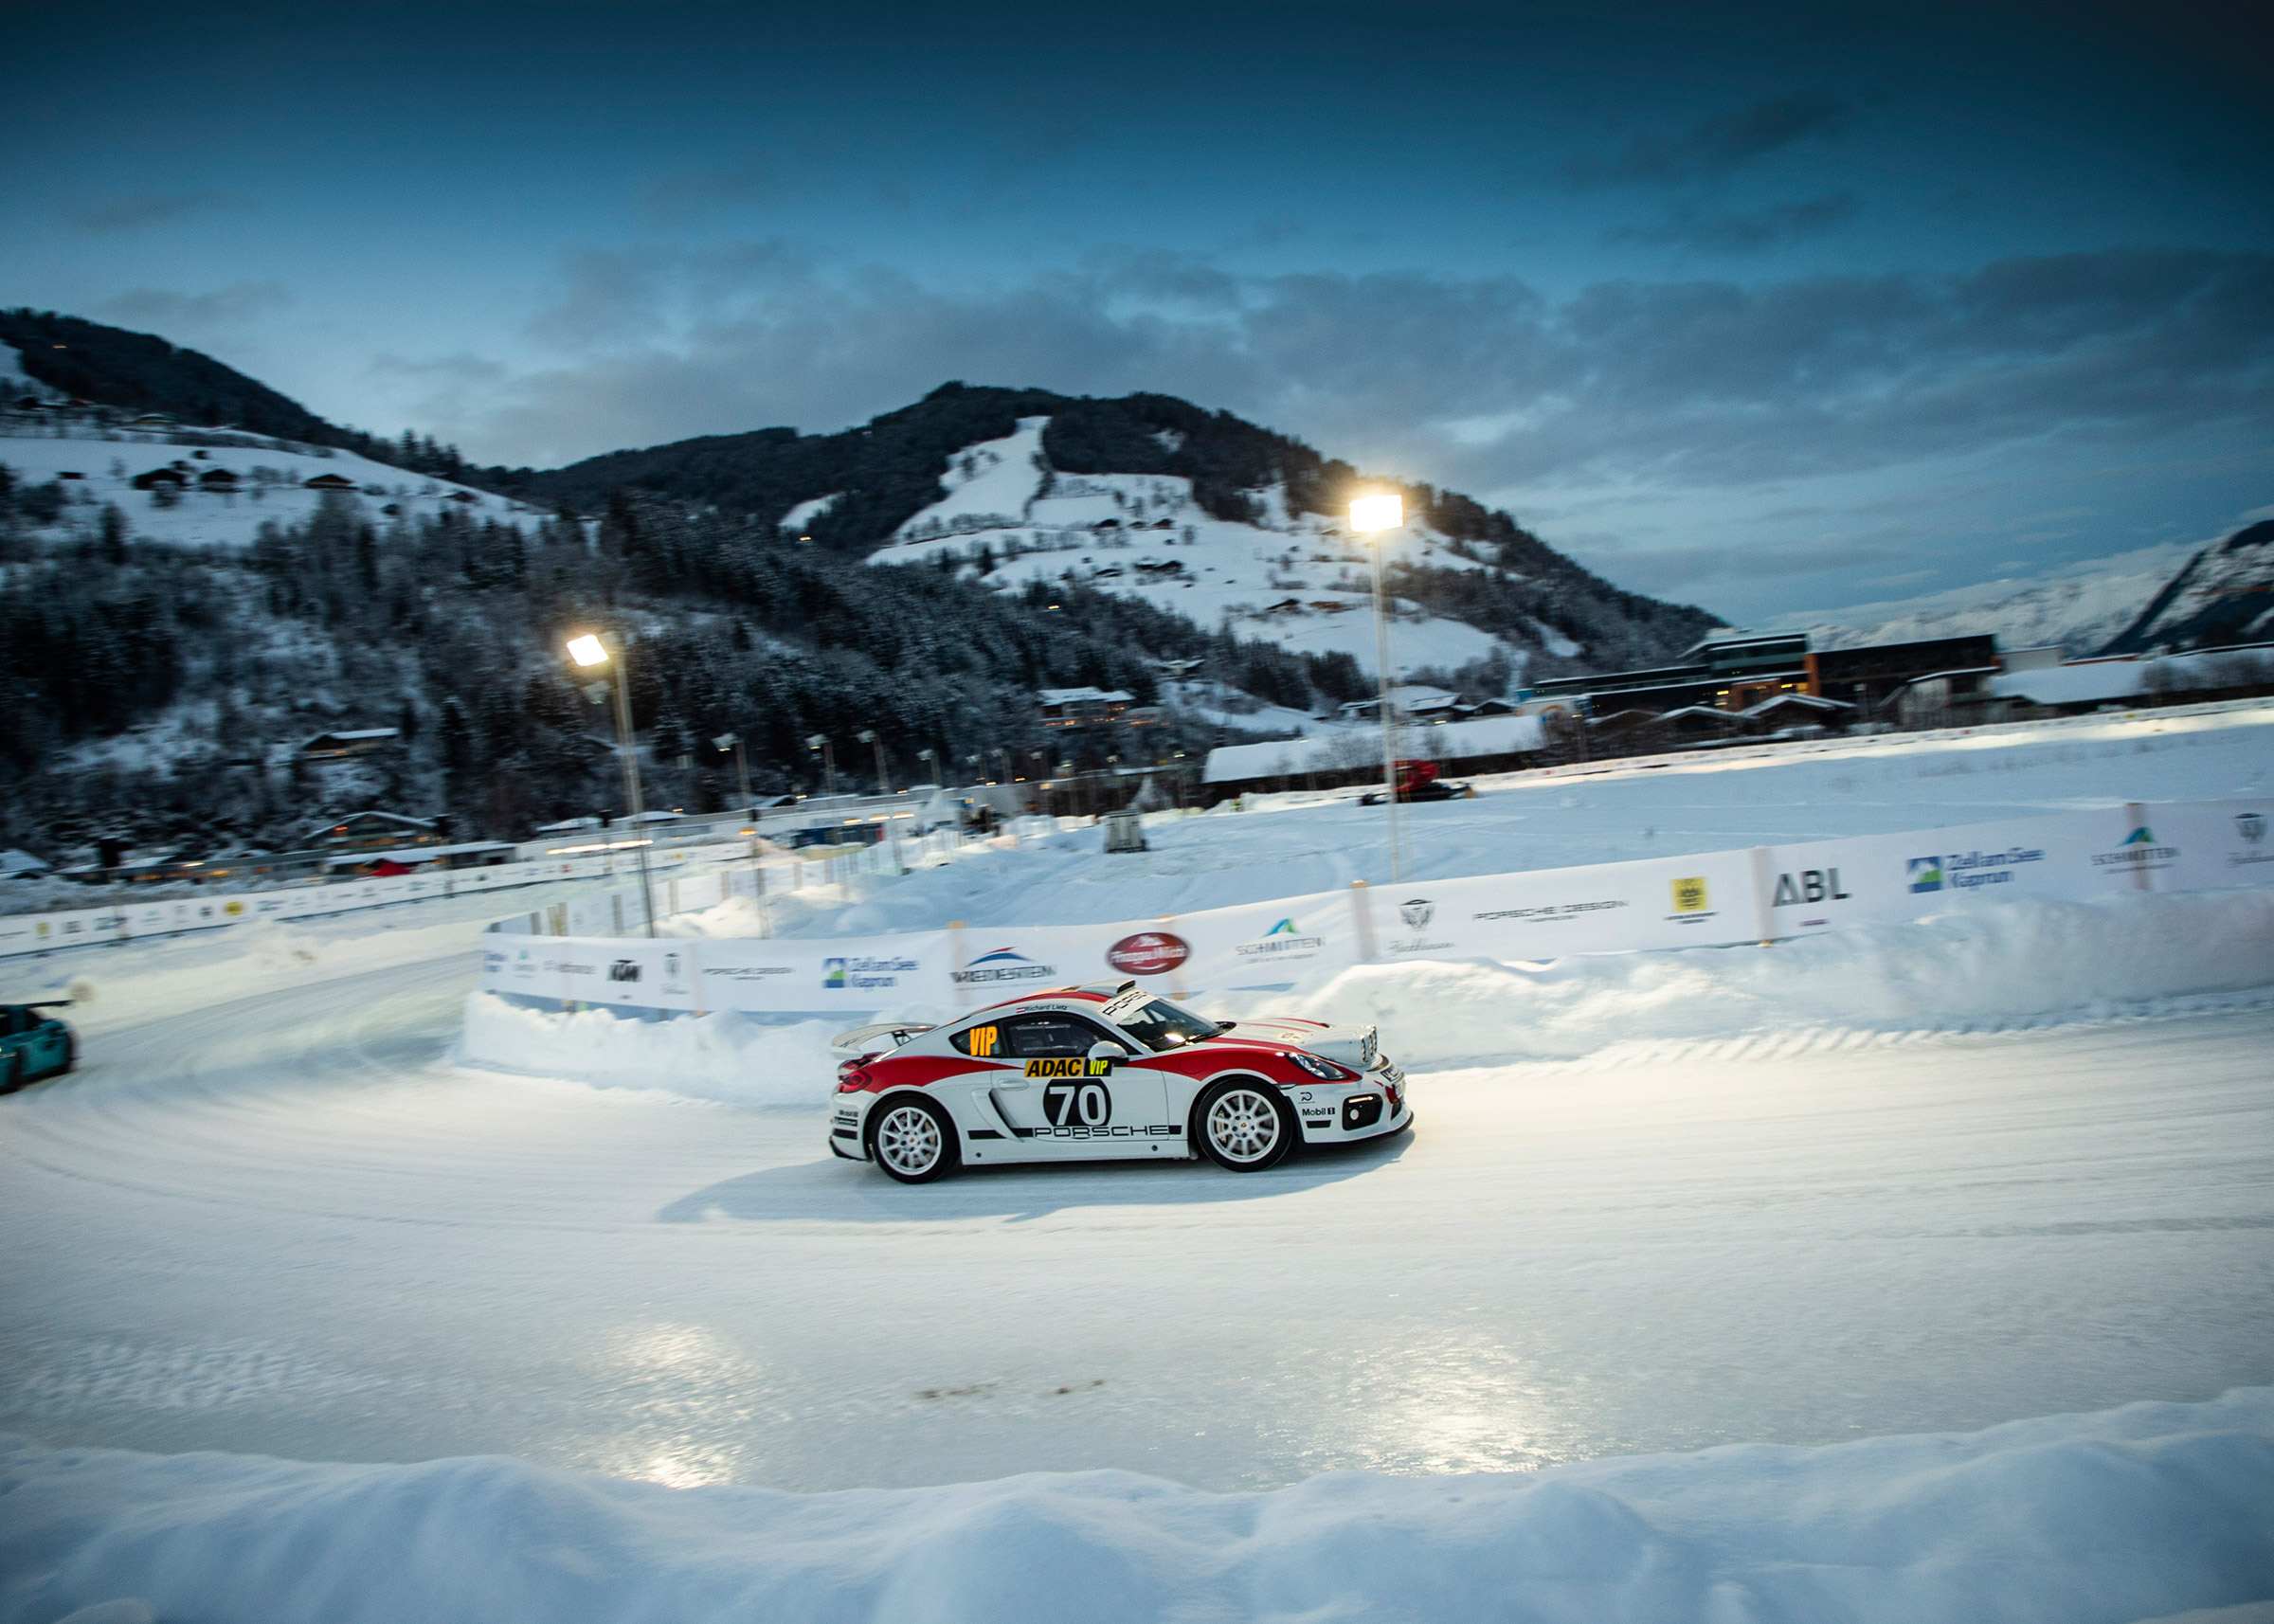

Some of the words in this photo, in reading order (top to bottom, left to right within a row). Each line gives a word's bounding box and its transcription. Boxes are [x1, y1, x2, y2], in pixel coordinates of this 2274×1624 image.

[1771, 868, 1852, 907] ABL
[969, 1026, 998, 1056] VIP
[1026, 1059, 1082, 1077] ADAC
[1089, 1059, 1109, 1075] VIP
[1049, 1085, 1107, 1127] 70
[1302, 1108, 1326, 1116] Mobil
[1035, 1125, 1169, 1138] PORSCHE
